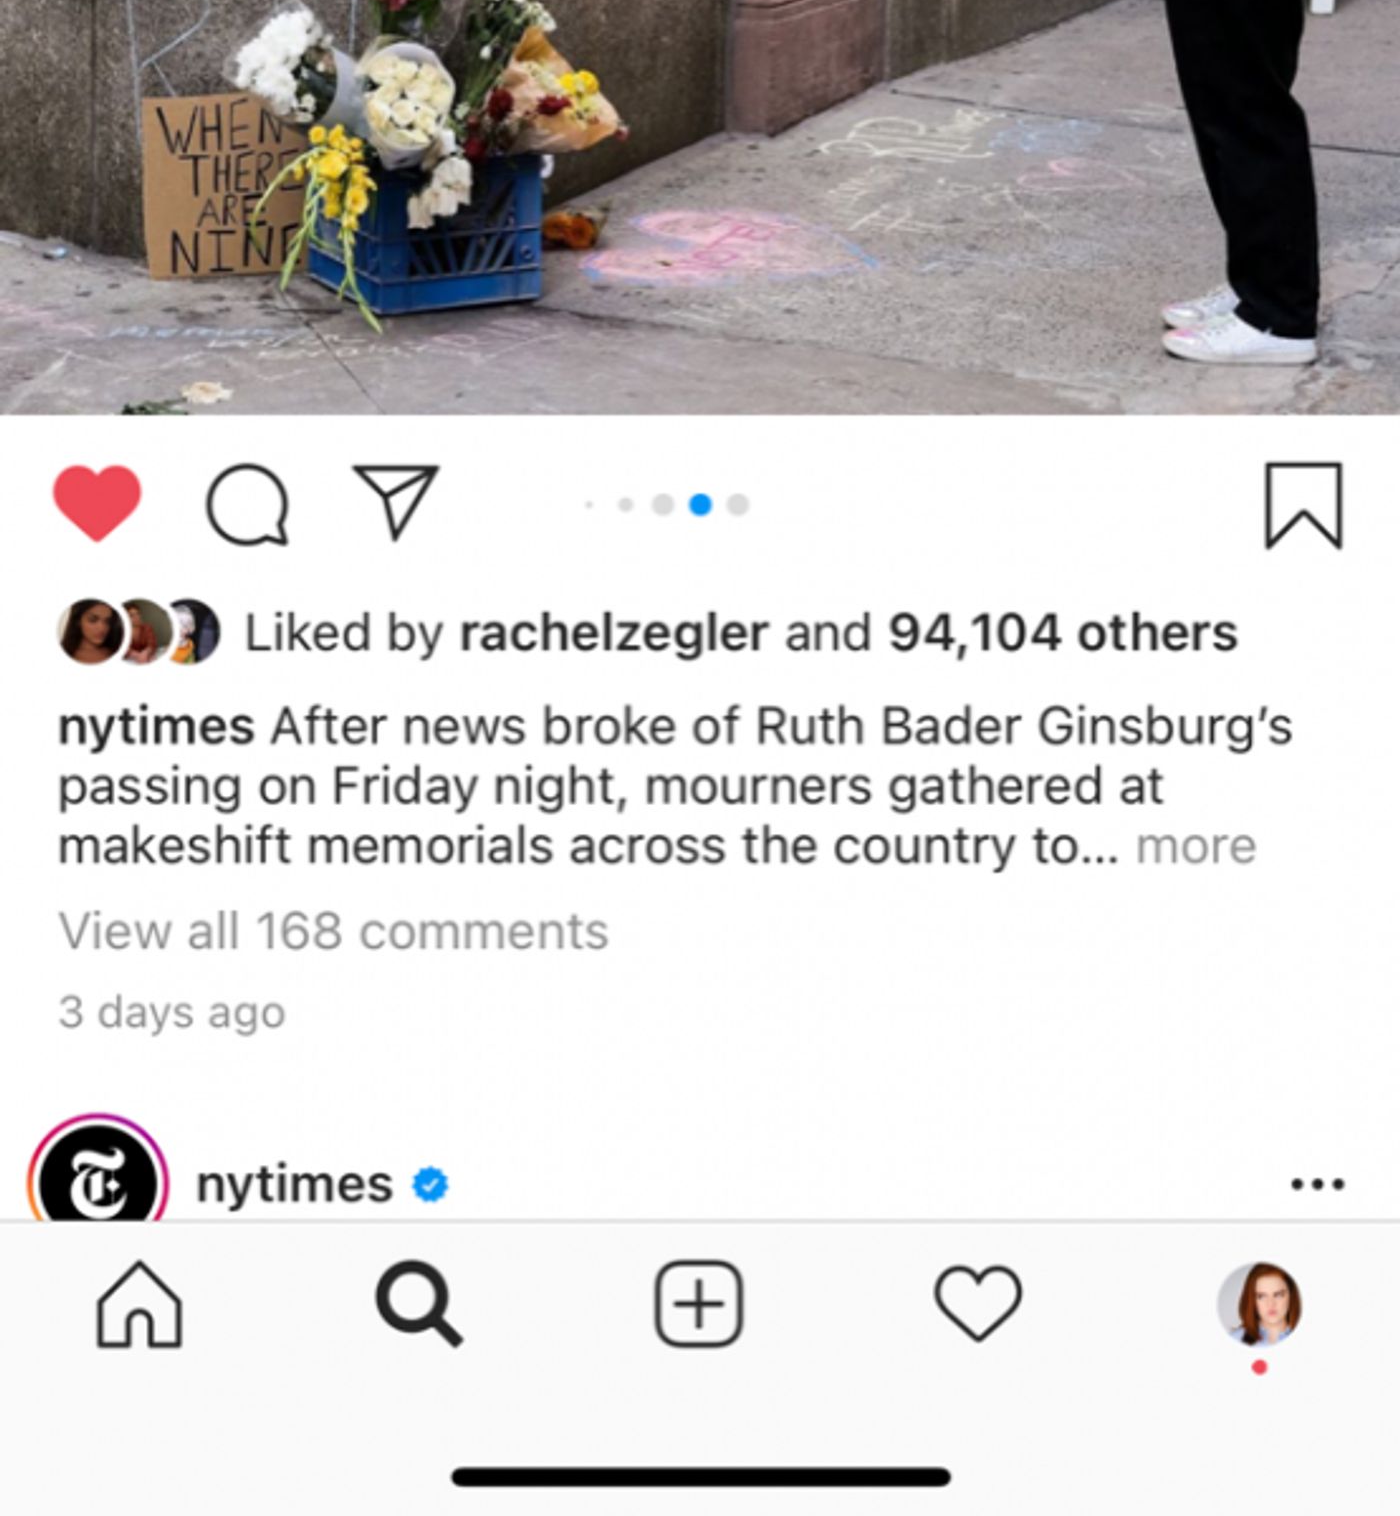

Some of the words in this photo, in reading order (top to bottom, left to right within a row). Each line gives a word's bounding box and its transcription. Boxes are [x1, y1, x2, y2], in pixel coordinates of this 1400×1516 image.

[156, 96, 282, 156] WHEN
[179, 148, 304, 197] THERE
[197, 193, 268, 228] ARE
[245, 609, 372, 654] Liked
[386, 609, 446, 663] by
[459, 608, 773, 663] rachelzegler
[784, 609, 873, 654] and
[887, 610, 1065, 663] 94,104
[1075, 608, 1240, 654] others
[57, 700, 257, 757] nytimes
[268, 701, 390, 748] After
[402, 713, 528, 748] news
[542, 702, 678, 748] broke
[690, 701, 743, 748] of
[756, 702, 866, 747] Ruth
[881, 702, 1024, 748] Bader
[57, 762, 243, 817] passing
[257, 772, 318, 807] on
[332, 762, 481, 816] Friday
[493, 762, 629, 817] night,
[644, 772, 874, 807] mourners
[886, 762, 1104, 817] gathered
[1118, 766, 1166, 807] at
[57, 821, 293, 867] makeshift
[306, 822, 556, 867] memorials
[568, 832, 728, 867] across
[739, 822, 820, 867] the
[832, 825, 1019, 875] country
[1136, 833, 1258, 866] more
[57, 908, 174, 952] View
[187, 908, 239, 952] all
[256, 909, 344, 952] 168
[358, 912, 610, 952] comments
[58, 993, 85, 1031] 3
[97, 992, 195, 1038] days
[207, 1001, 287, 1038] ago
[195, 1158, 395, 1214] nytimes
